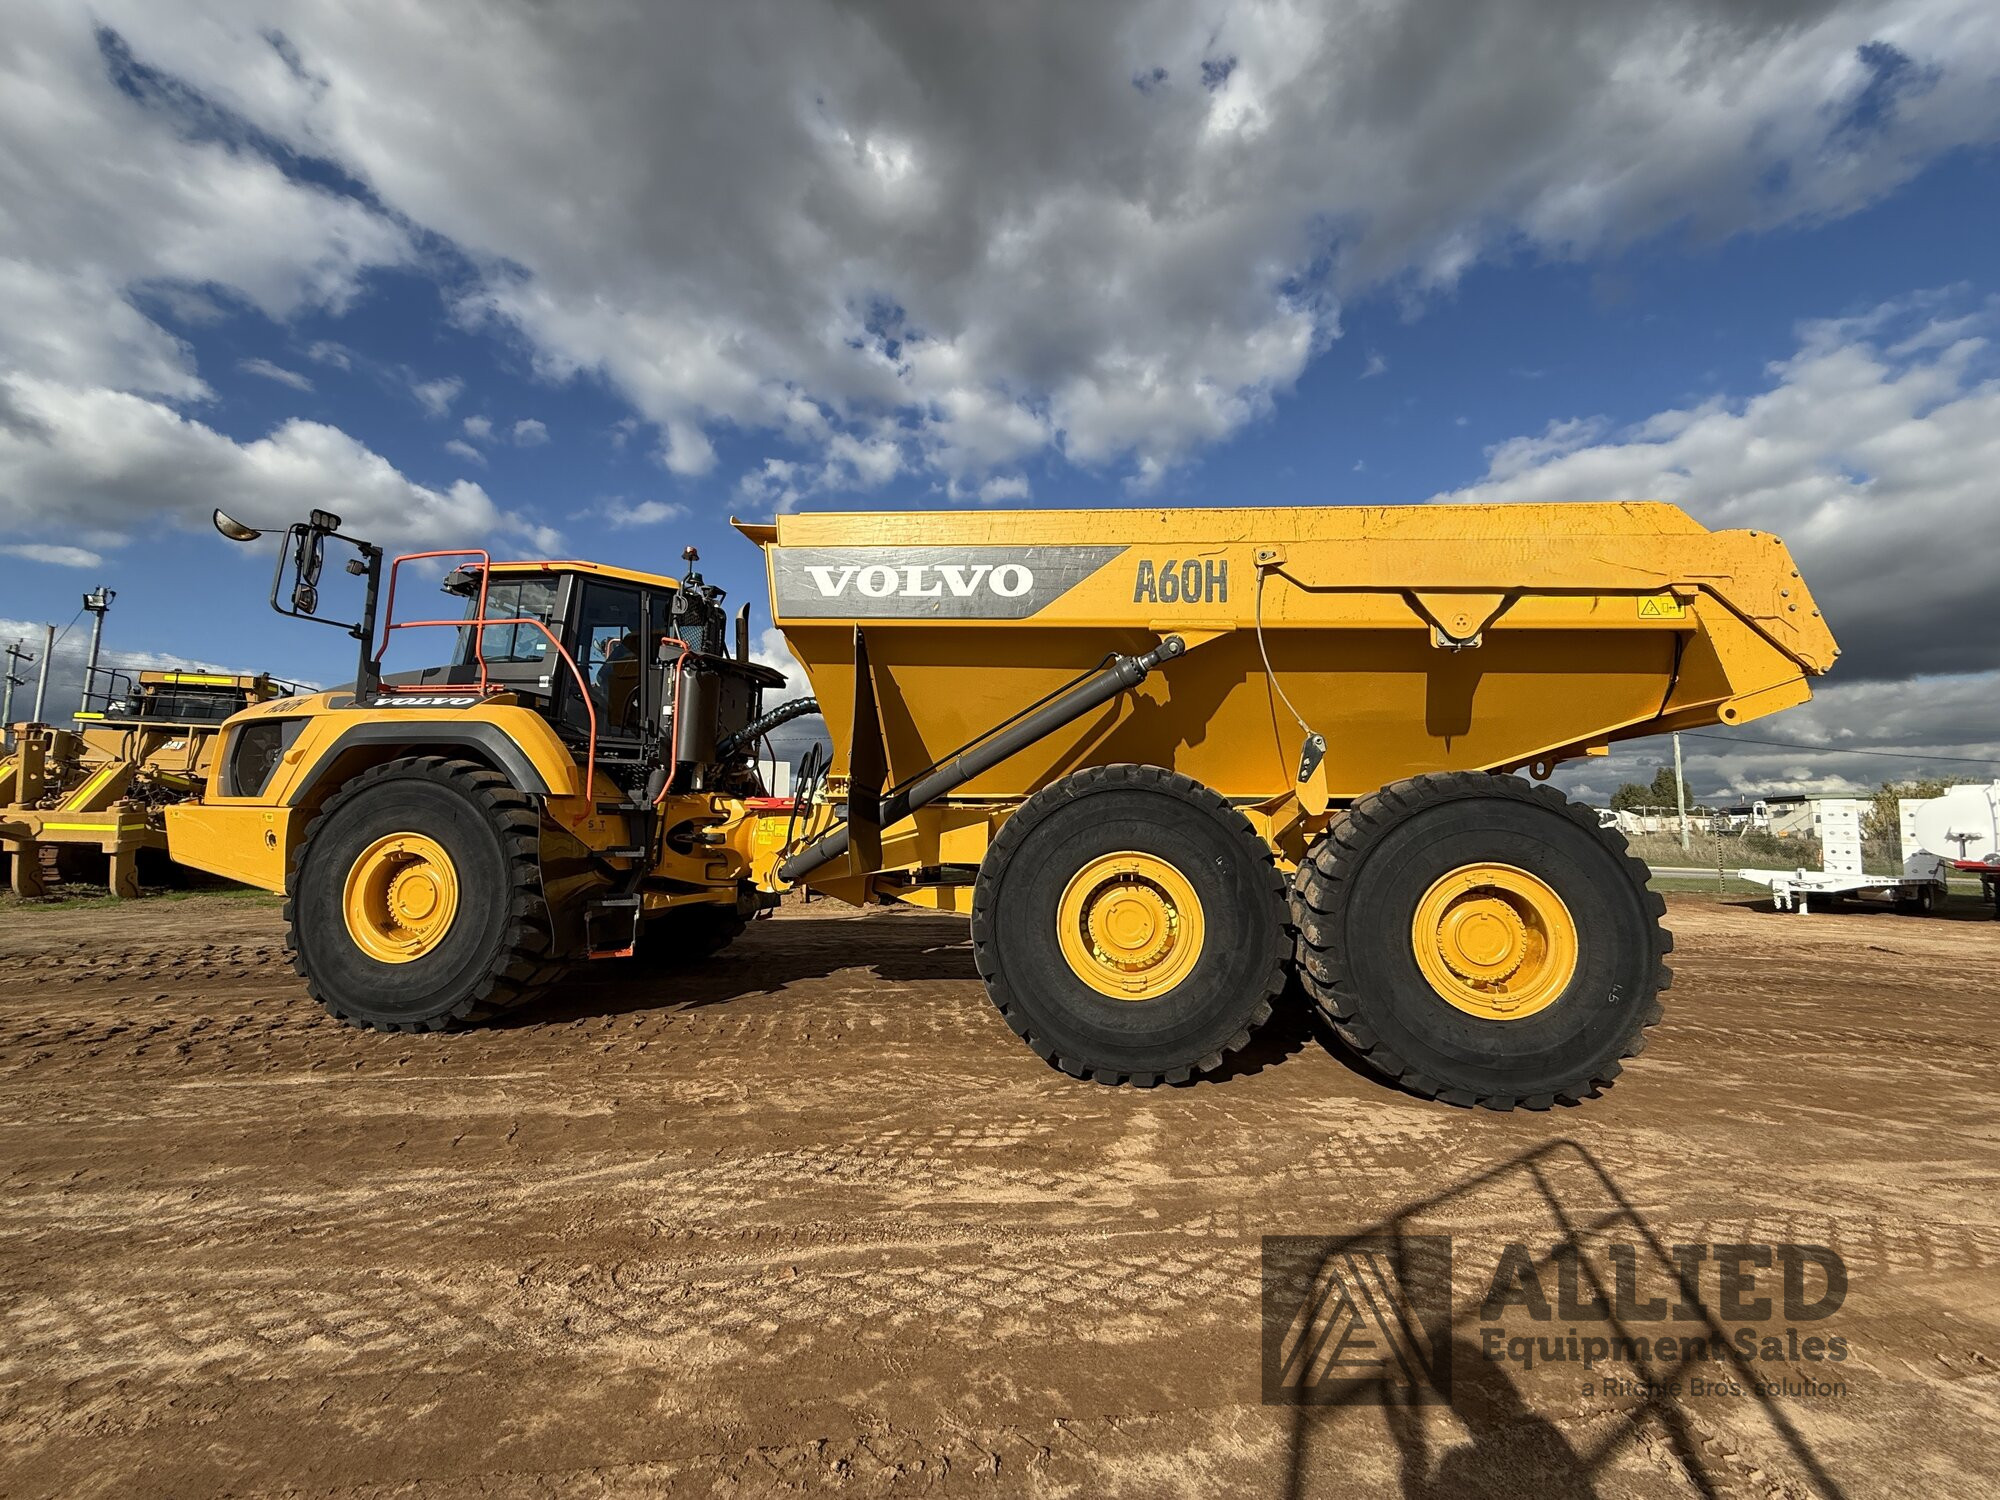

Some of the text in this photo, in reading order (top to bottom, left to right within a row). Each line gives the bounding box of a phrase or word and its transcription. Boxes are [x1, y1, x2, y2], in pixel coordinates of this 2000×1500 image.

[804, 564, 1034, 597] VOLVO
[1133, 559, 1228, 604] A60H
[374, 697, 476, 706] VOLVO
